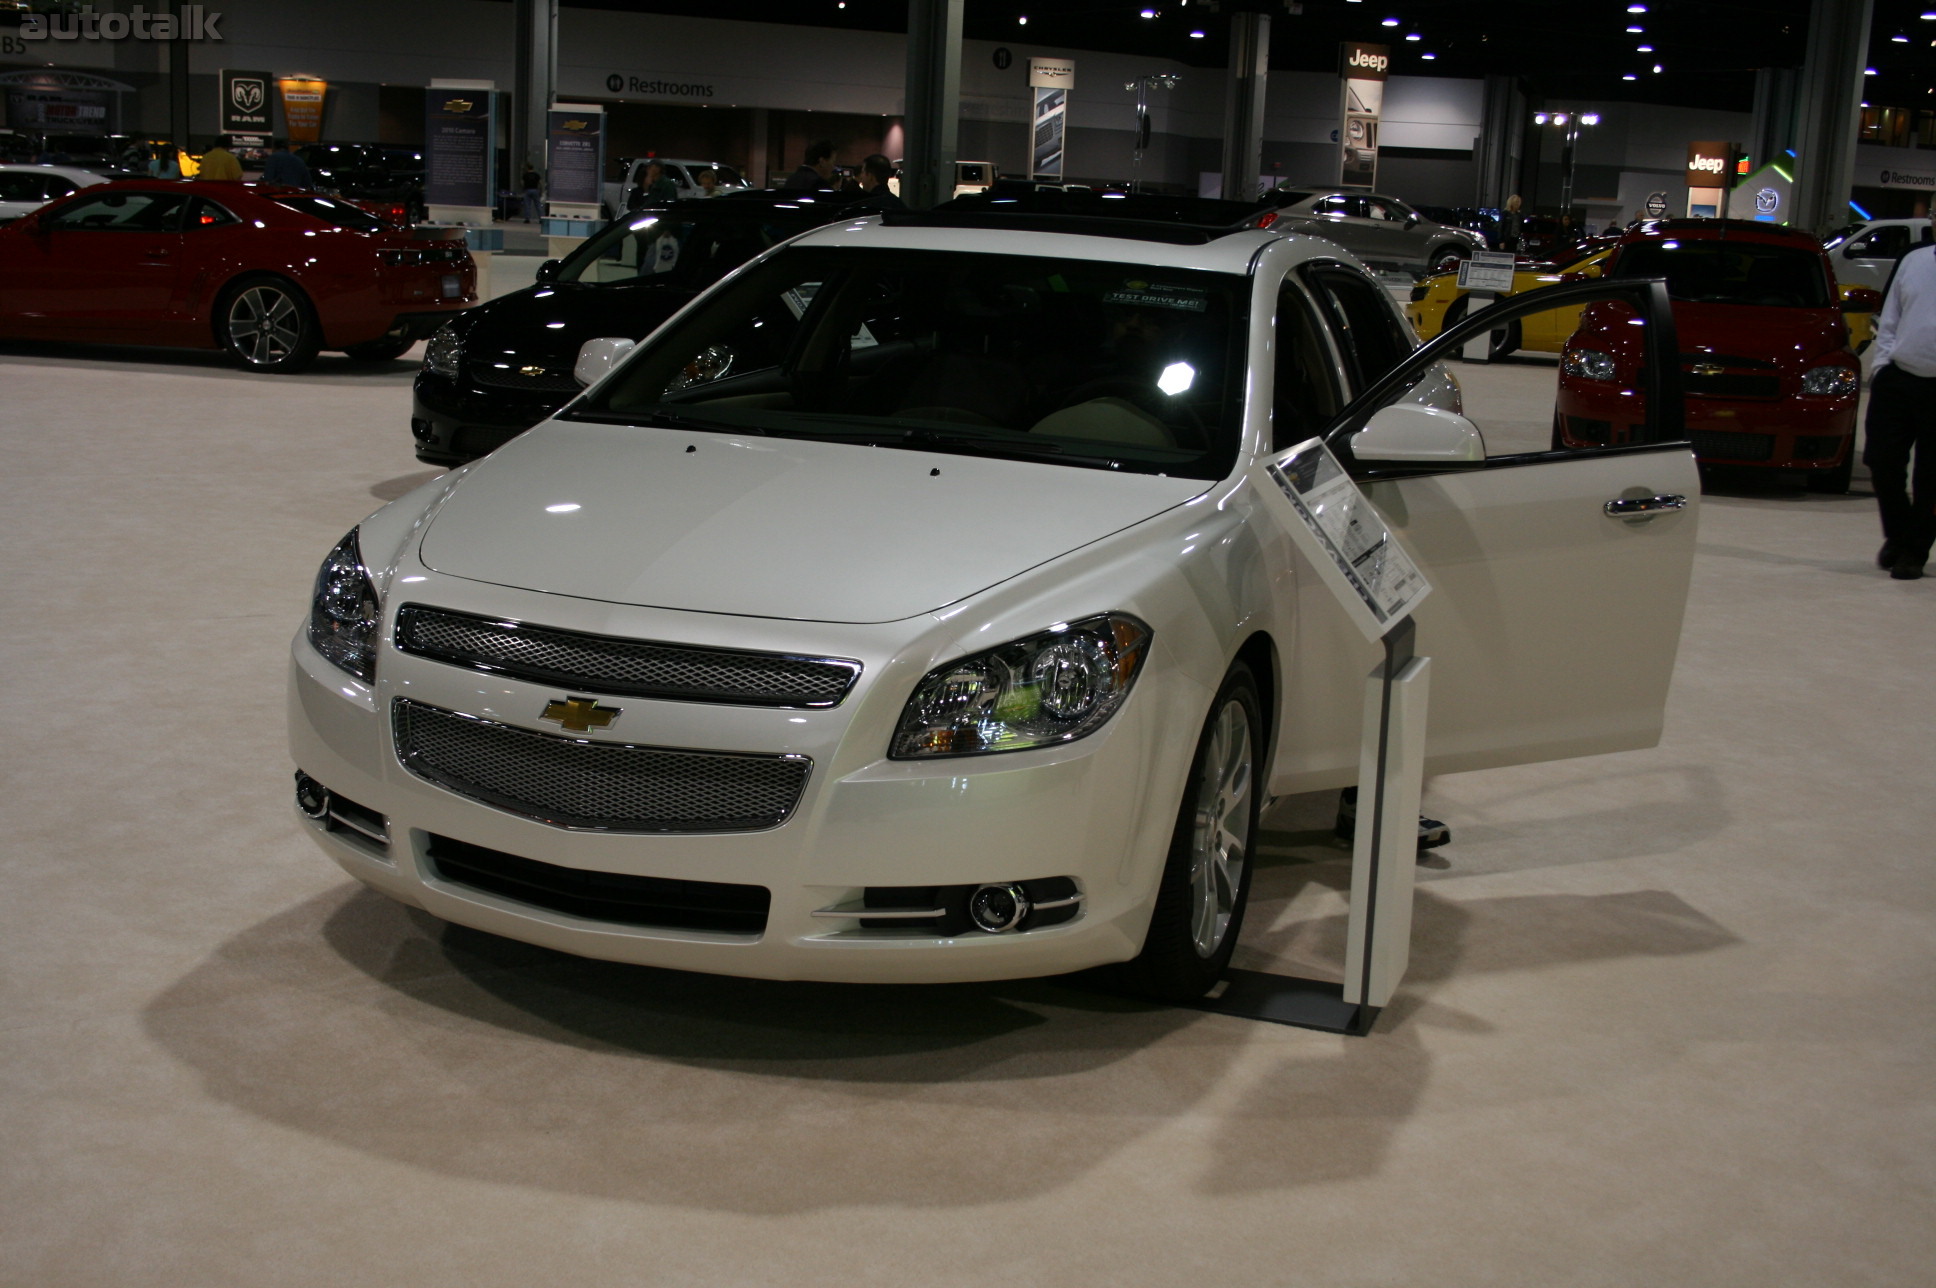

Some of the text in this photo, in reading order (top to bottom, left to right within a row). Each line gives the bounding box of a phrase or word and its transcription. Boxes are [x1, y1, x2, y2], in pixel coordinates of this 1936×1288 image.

[1349, 48, 1388, 72] Jeep
[1033, 65, 1073, 73] CHRYSLER
[629, 76, 714, 97] Restrooms
[79, 105, 107, 119] TREND
[231, 115, 265, 123] RAM
[1689, 154, 1724, 174] Jeep
[1891, 171, 1935, 186] Restrooms
[1648, 202, 1667, 210] VOLVO
[1112, 292, 1139, 300] TEST
[1141, 295, 1175, 303] DRIVE
